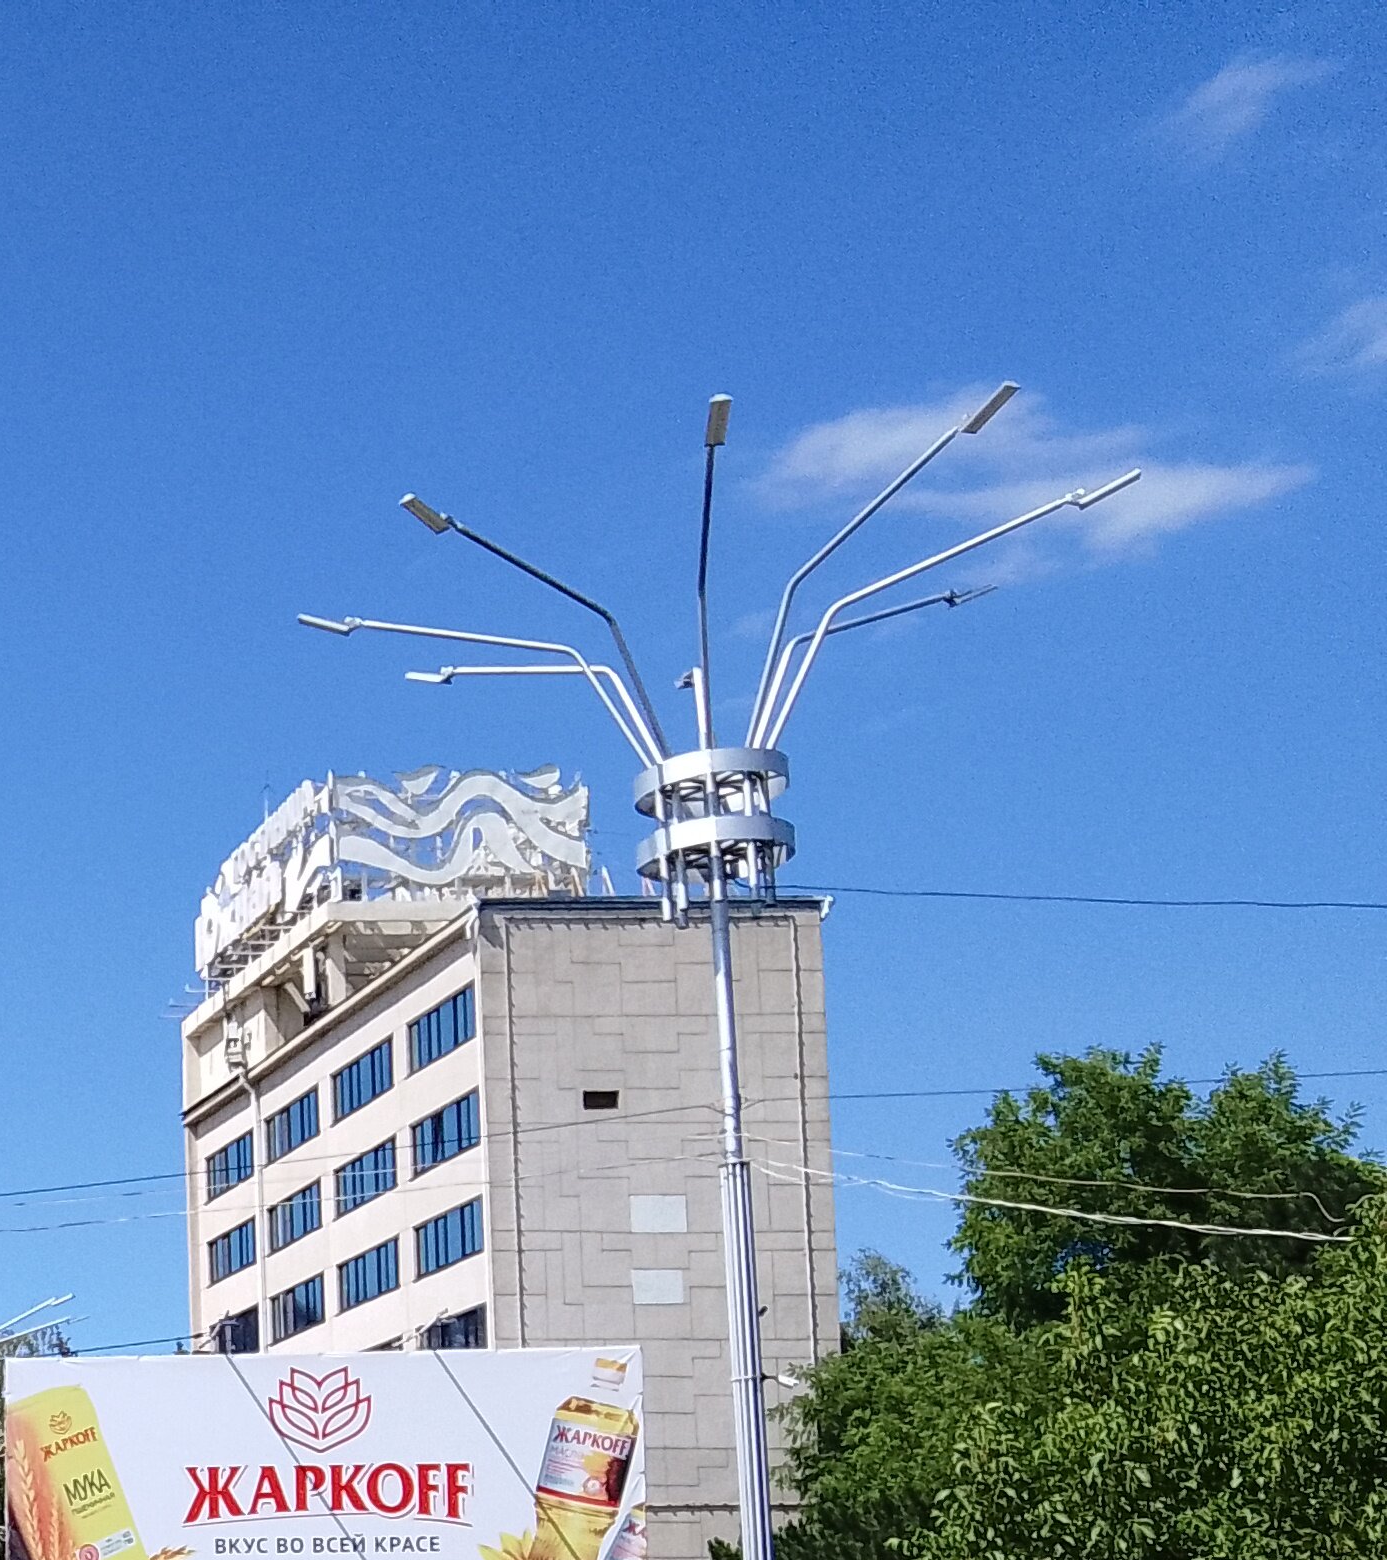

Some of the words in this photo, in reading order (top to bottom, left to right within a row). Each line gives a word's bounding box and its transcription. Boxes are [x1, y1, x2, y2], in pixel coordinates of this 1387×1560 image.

[63, 1468, 111, 1506] МУКА
[182, 1462, 473, 1524] ЖАРКОFF
[214, 1537, 269, 1554] ВКУС
[277, 1537, 304, 1553] ВО
[312, 1534, 366, 1553] ВСЕЙ
[374, 1536, 441, 1552] КРАСЕ
